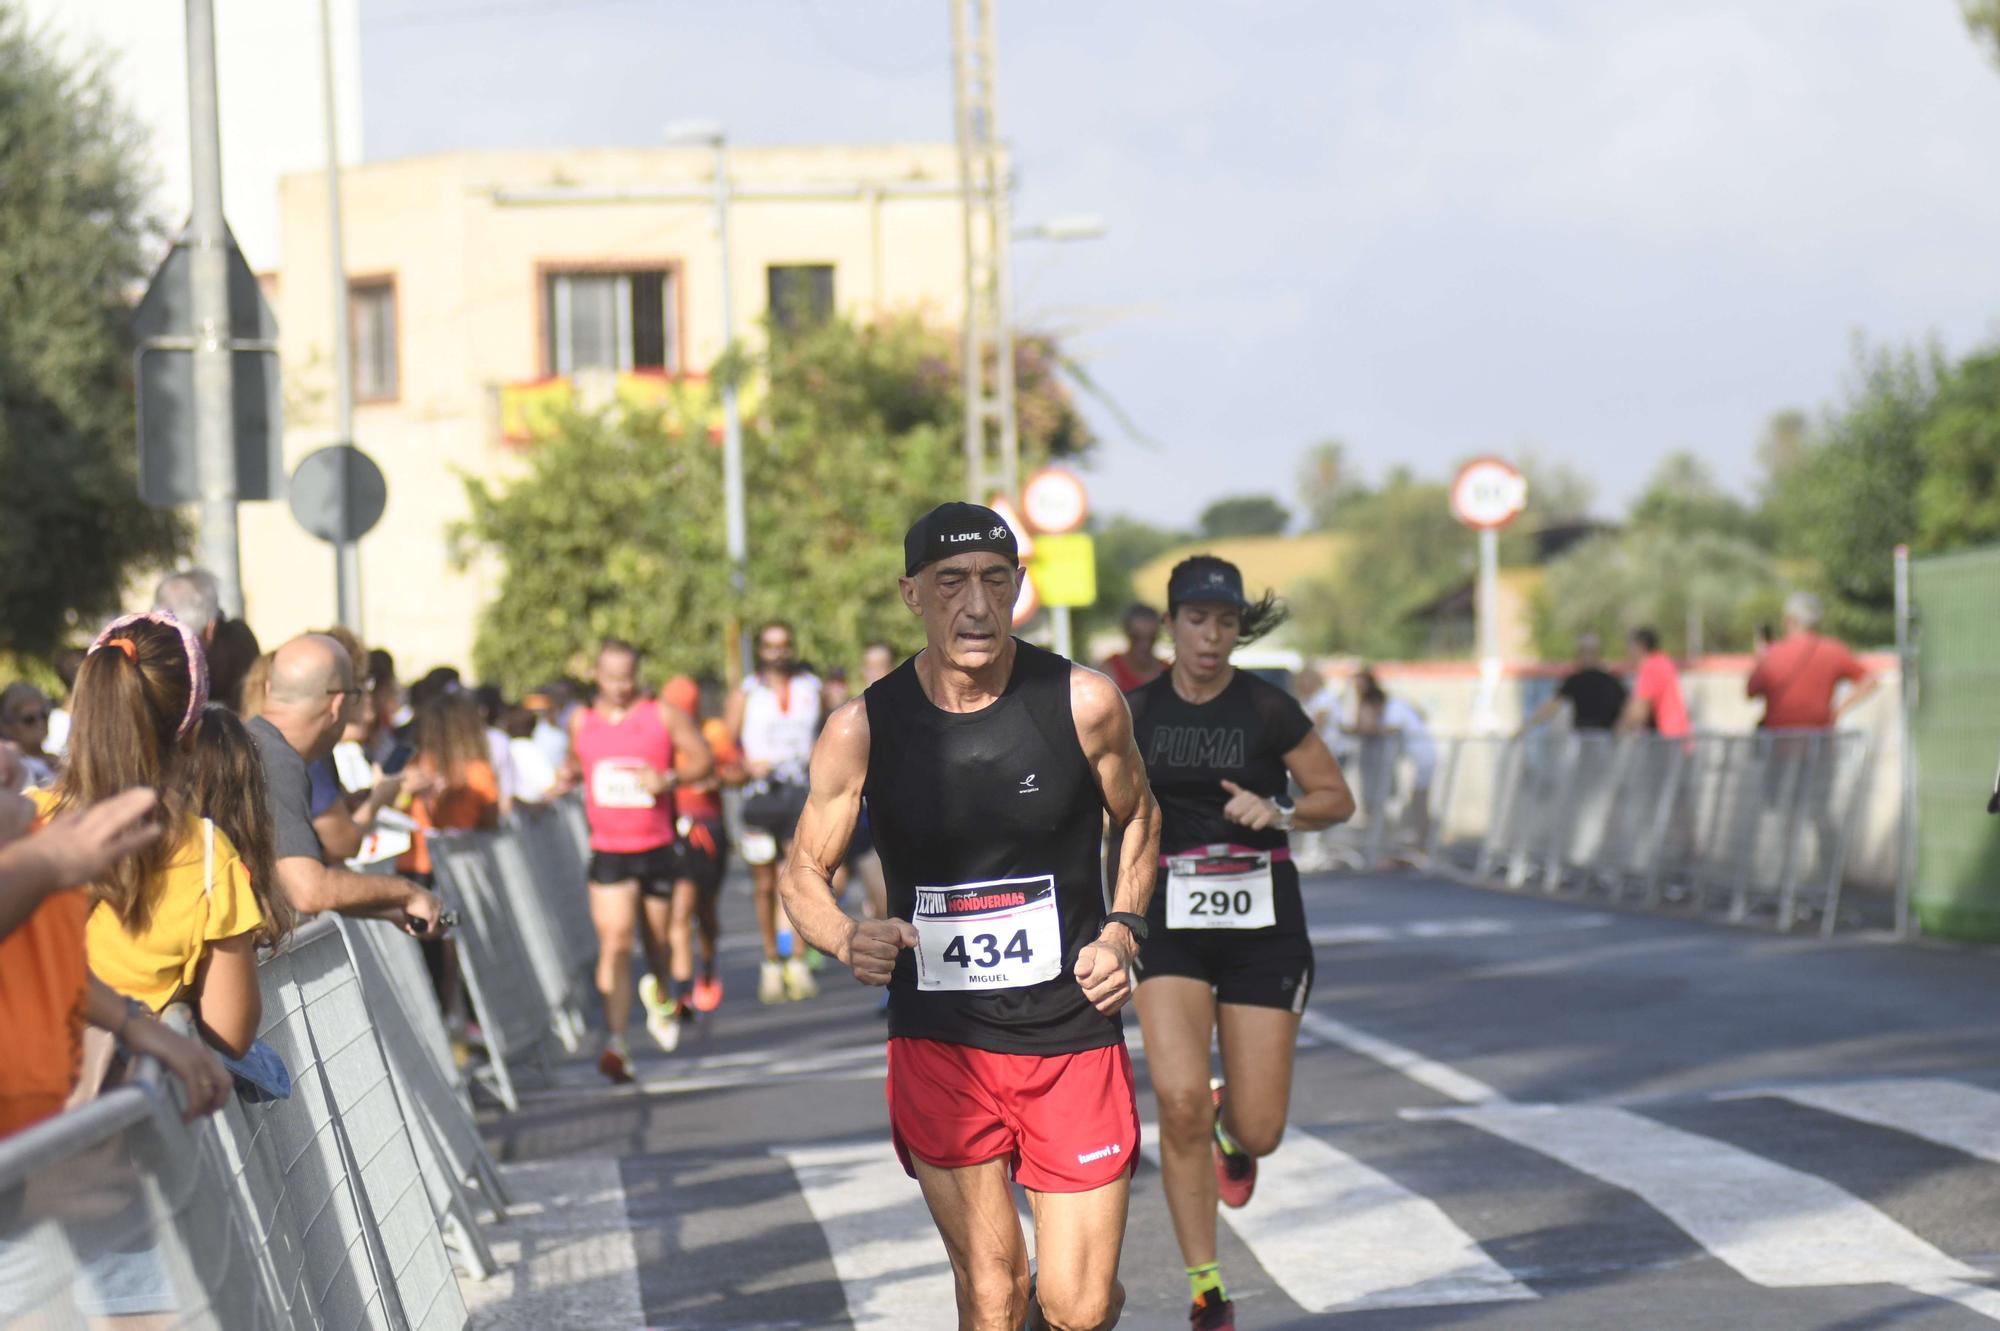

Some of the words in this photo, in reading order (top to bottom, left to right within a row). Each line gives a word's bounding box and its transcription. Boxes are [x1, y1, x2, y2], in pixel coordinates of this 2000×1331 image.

[940, 534, 945, 542] I
[950, 532, 982, 542] LOVE
[1148, 726, 1244, 768] PUMA
[1189, 890, 1251, 916] 290
[942, 929, 1034, 968] 434
[970, 974, 1009, 983] MIGUEL
